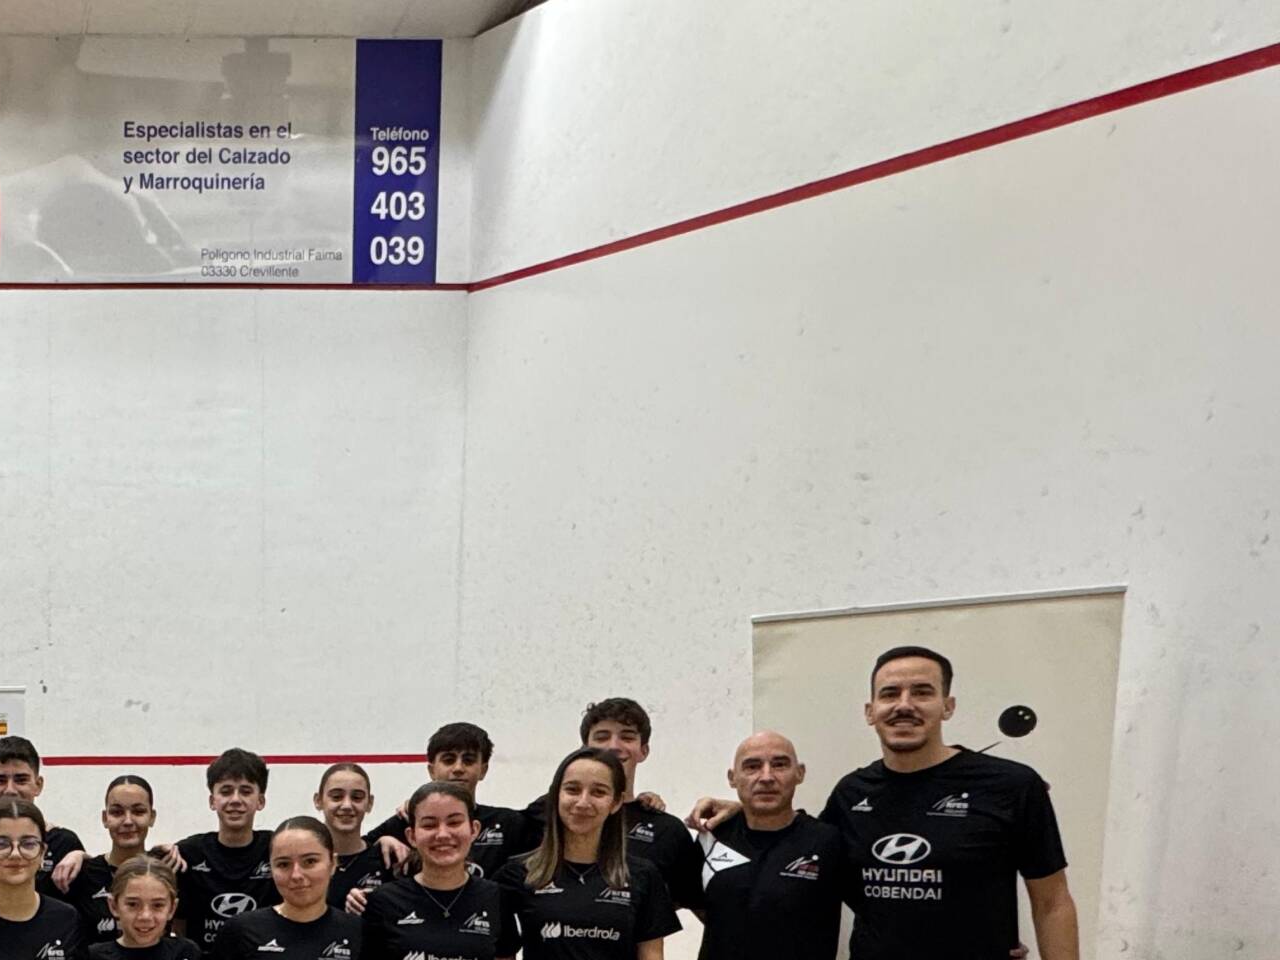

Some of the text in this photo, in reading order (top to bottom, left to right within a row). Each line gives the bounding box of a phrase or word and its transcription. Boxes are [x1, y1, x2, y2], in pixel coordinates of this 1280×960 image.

[123, 121, 292, 142] Especialistas en el
[370, 127, 430, 141] Teléfono
[123, 147, 291, 164] sector del Calzado
[371, 146, 427, 176] 965
[123, 171, 265, 194] y Marroquinería
[370, 191, 426, 220] 403
[254, 248, 305, 261] Industrial
[370, 236, 425, 265] 039
[239, 265, 299, 277] Crevillente
[862, 868, 942, 883] HYUNDAI
[864, 885, 942, 900] COBENDAI
[564, 925, 620, 941] Iberdrola
